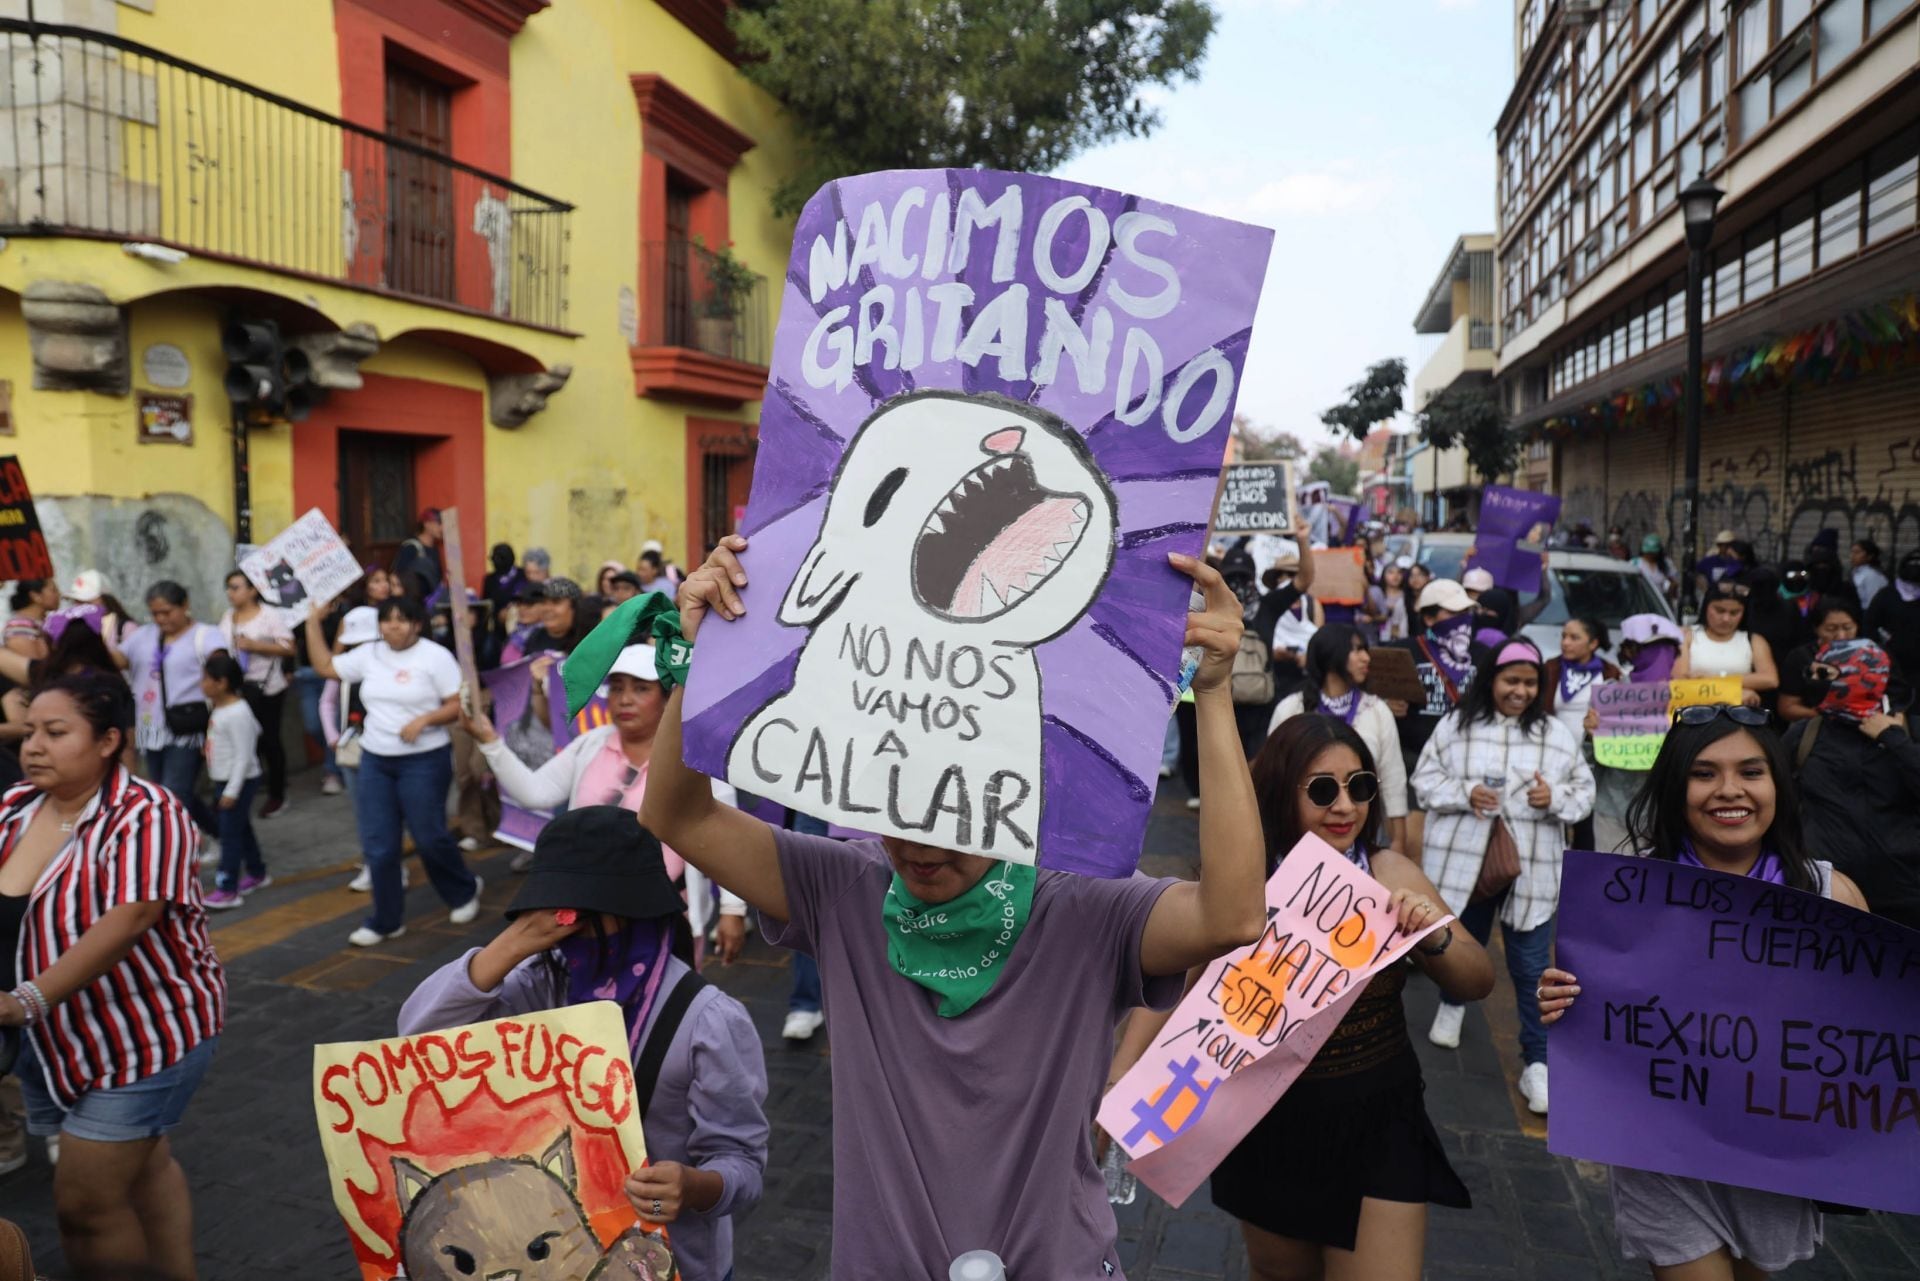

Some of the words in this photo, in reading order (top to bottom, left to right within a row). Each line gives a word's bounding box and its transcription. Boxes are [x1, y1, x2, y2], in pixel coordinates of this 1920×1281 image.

[808, 184, 1181, 319] NACIMOS
[801, 283, 1235, 444] GRITANDO
[838, 622, 891, 678] NO
[904, 637, 1017, 700] NOS
[1597, 688, 1685, 705] GRACIAS
[1699, 683, 1722, 698] AL
[852, 679, 982, 741] VAMOS
[873, 729, 909, 759] A
[751, 718, 1034, 850] CALLAR
[1285, 861, 1376, 948] NOS
[1604, 865, 1648, 904] SI
[1665, 872, 1736, 914] LOS
[980, 950, 999, 968] de
[1708, 920, 1886, 979] FUERAN
[1603, 995, 1758, 1063] MÉXICO
[321, 1030, 496, 1134] SOMOS
[495, 1021, 634, 1125] FUEGO
[1649, 1058, 1709, 1106] EN
[1745, 1071, 1920, 1134] LLAMA
